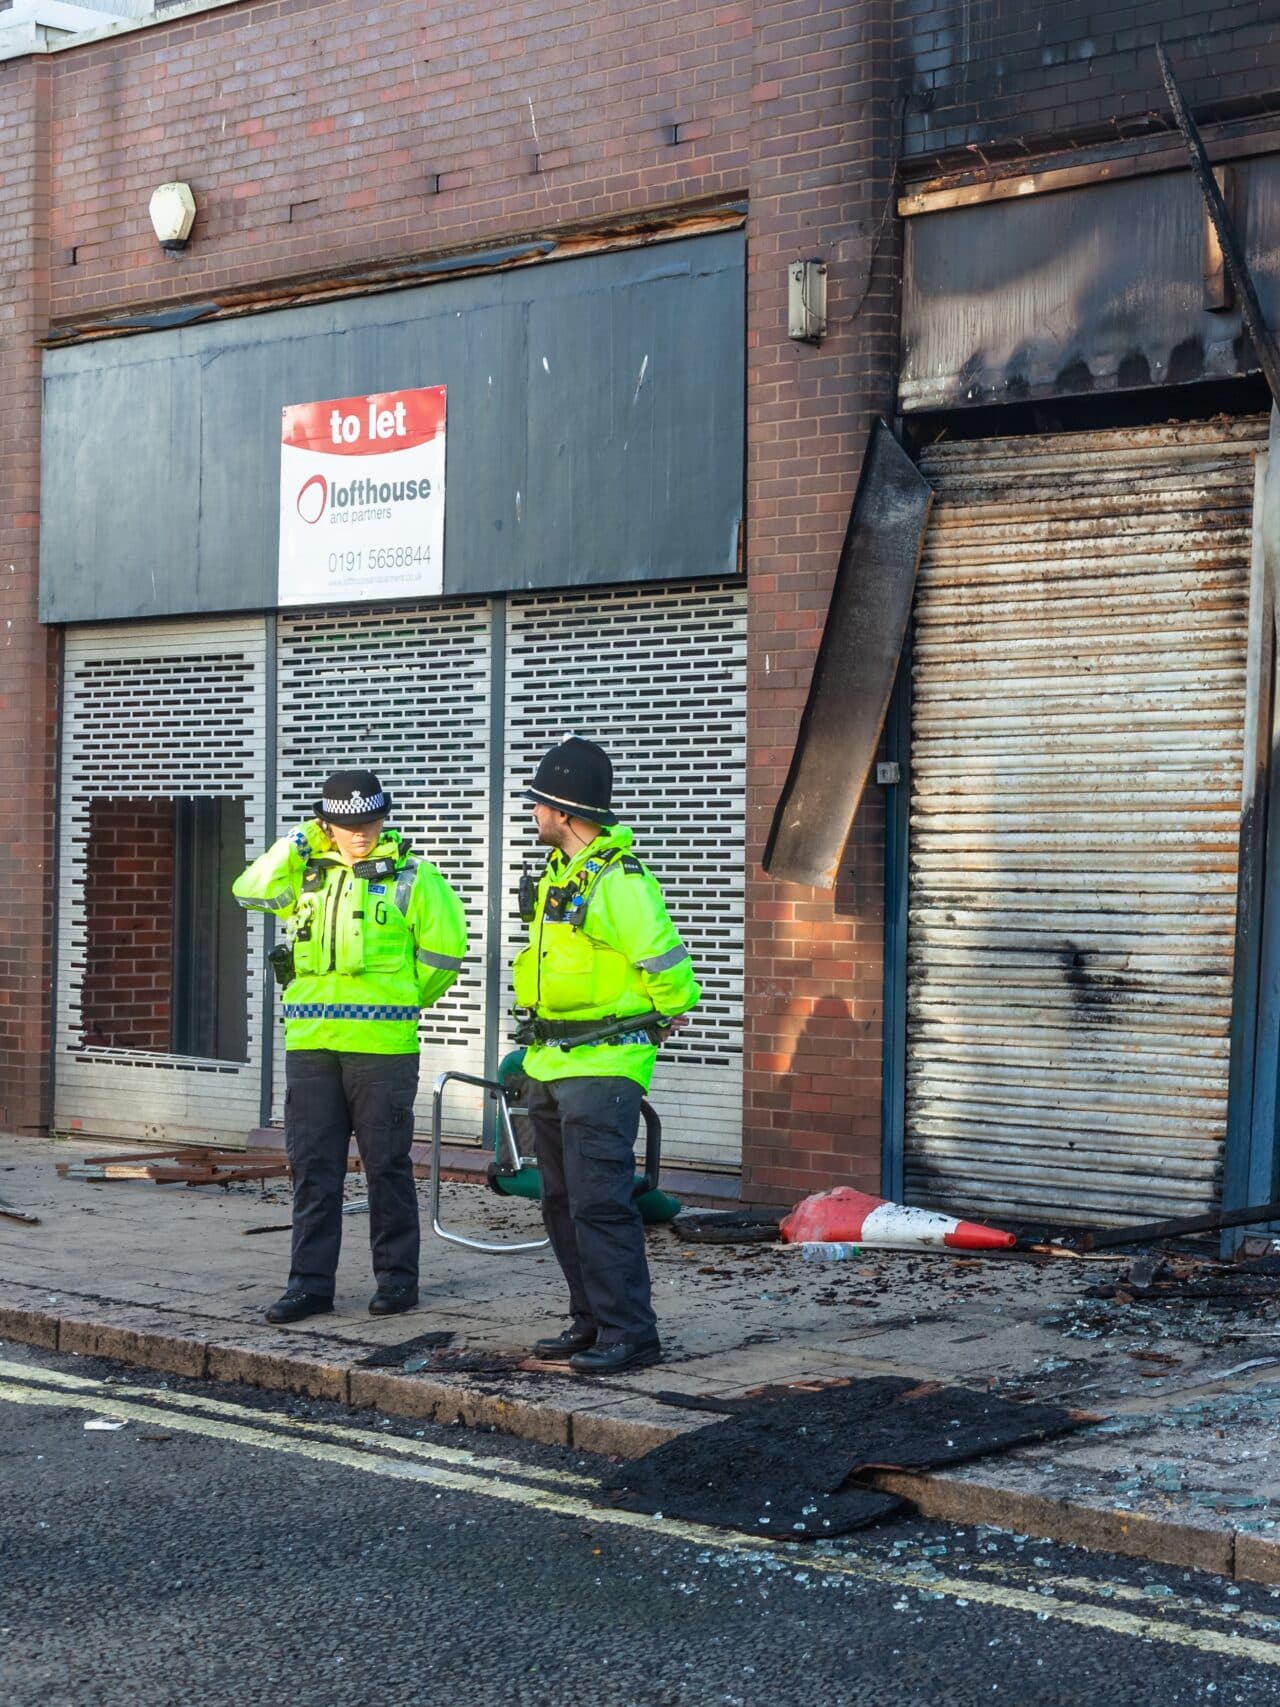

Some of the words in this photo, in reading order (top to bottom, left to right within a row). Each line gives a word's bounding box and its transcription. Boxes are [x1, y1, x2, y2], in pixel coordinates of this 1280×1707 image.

[330, 409, 360, 444] to
[368, 401, 406, 440] let
[330, 478, 431, 508] lofthouse
[330, 509, 349, 524] and
[351, 507, 392, 525] partners
[328, 551, 362, 573] 0191
[368, 545, 431, 570] 5658844
